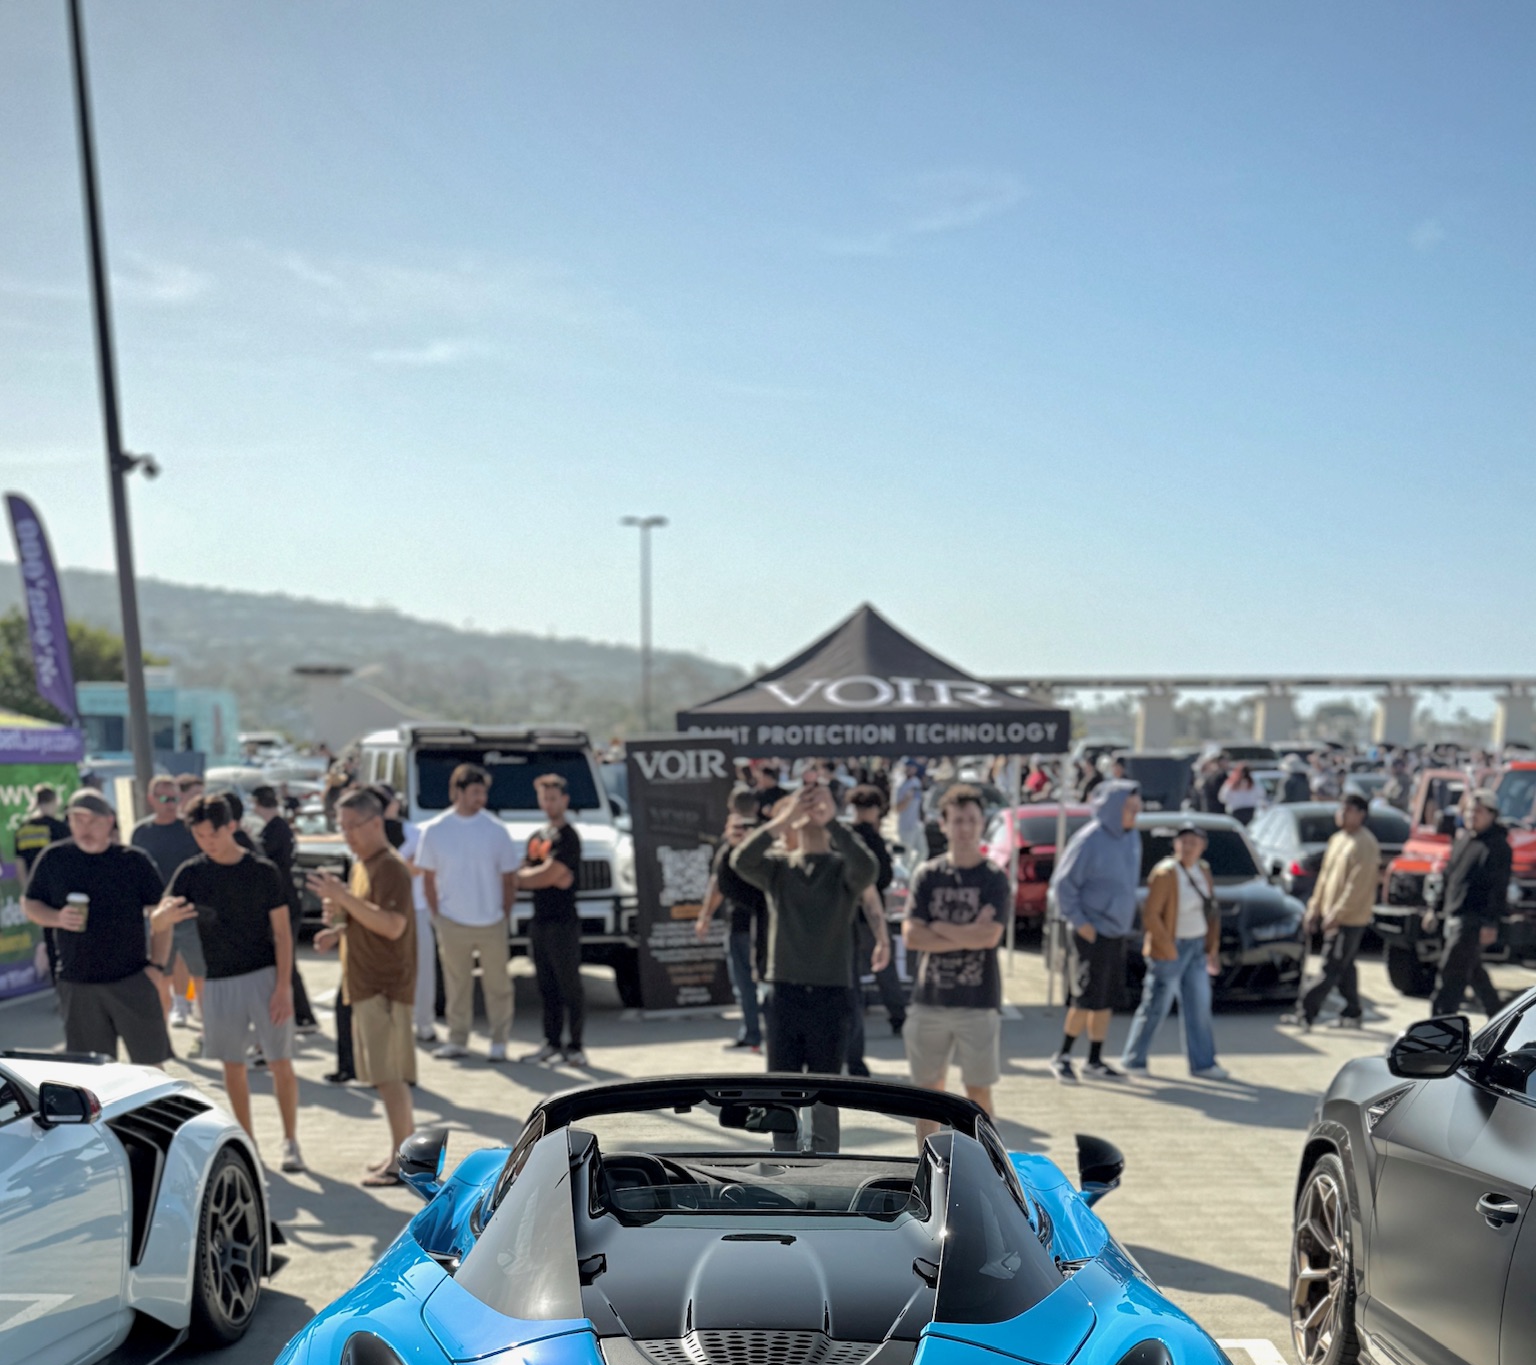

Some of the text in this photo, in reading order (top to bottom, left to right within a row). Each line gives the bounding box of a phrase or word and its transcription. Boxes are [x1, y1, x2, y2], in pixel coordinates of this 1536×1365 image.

[755, 675, 1002, 708] VOIR
[757, 724, 896, 745] PROTECTION
[904, 722, 1058, 744] TECHNOLOGY
[632, 749, 729, 780] VOIR
